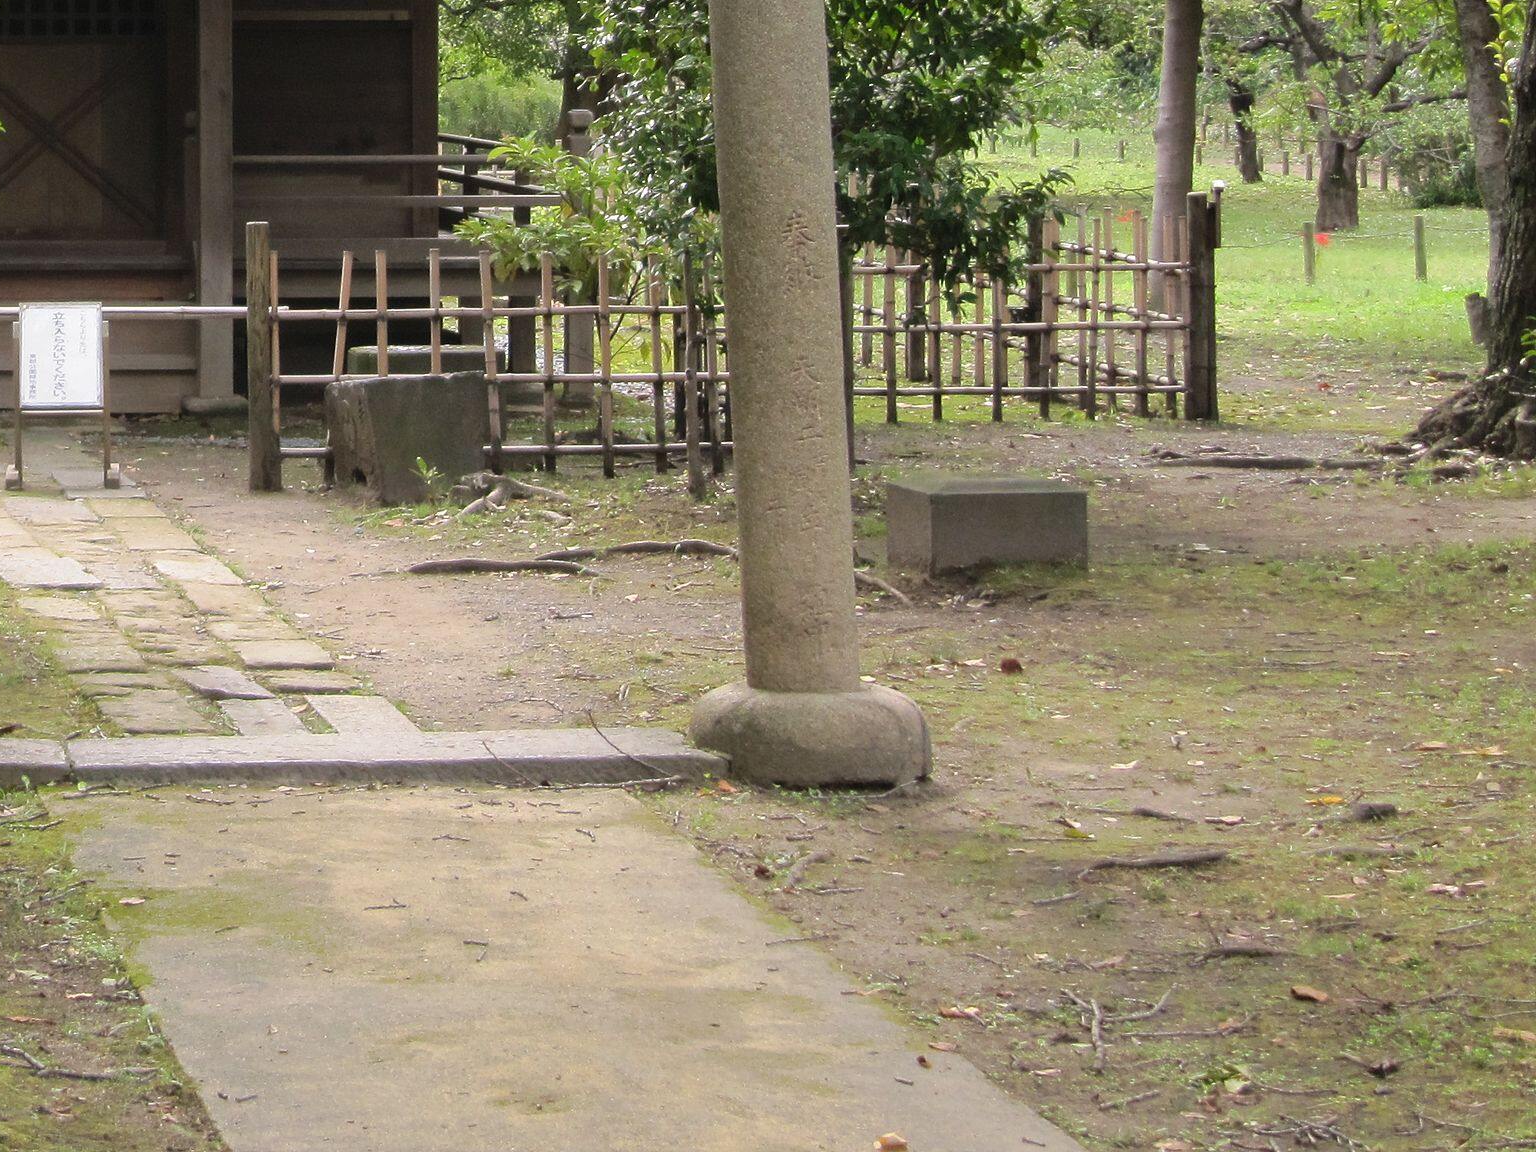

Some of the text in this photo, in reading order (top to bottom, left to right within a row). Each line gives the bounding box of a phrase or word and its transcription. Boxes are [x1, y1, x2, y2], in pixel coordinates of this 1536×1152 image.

[52, 312, 67, 400] 立ち入らないでください。
